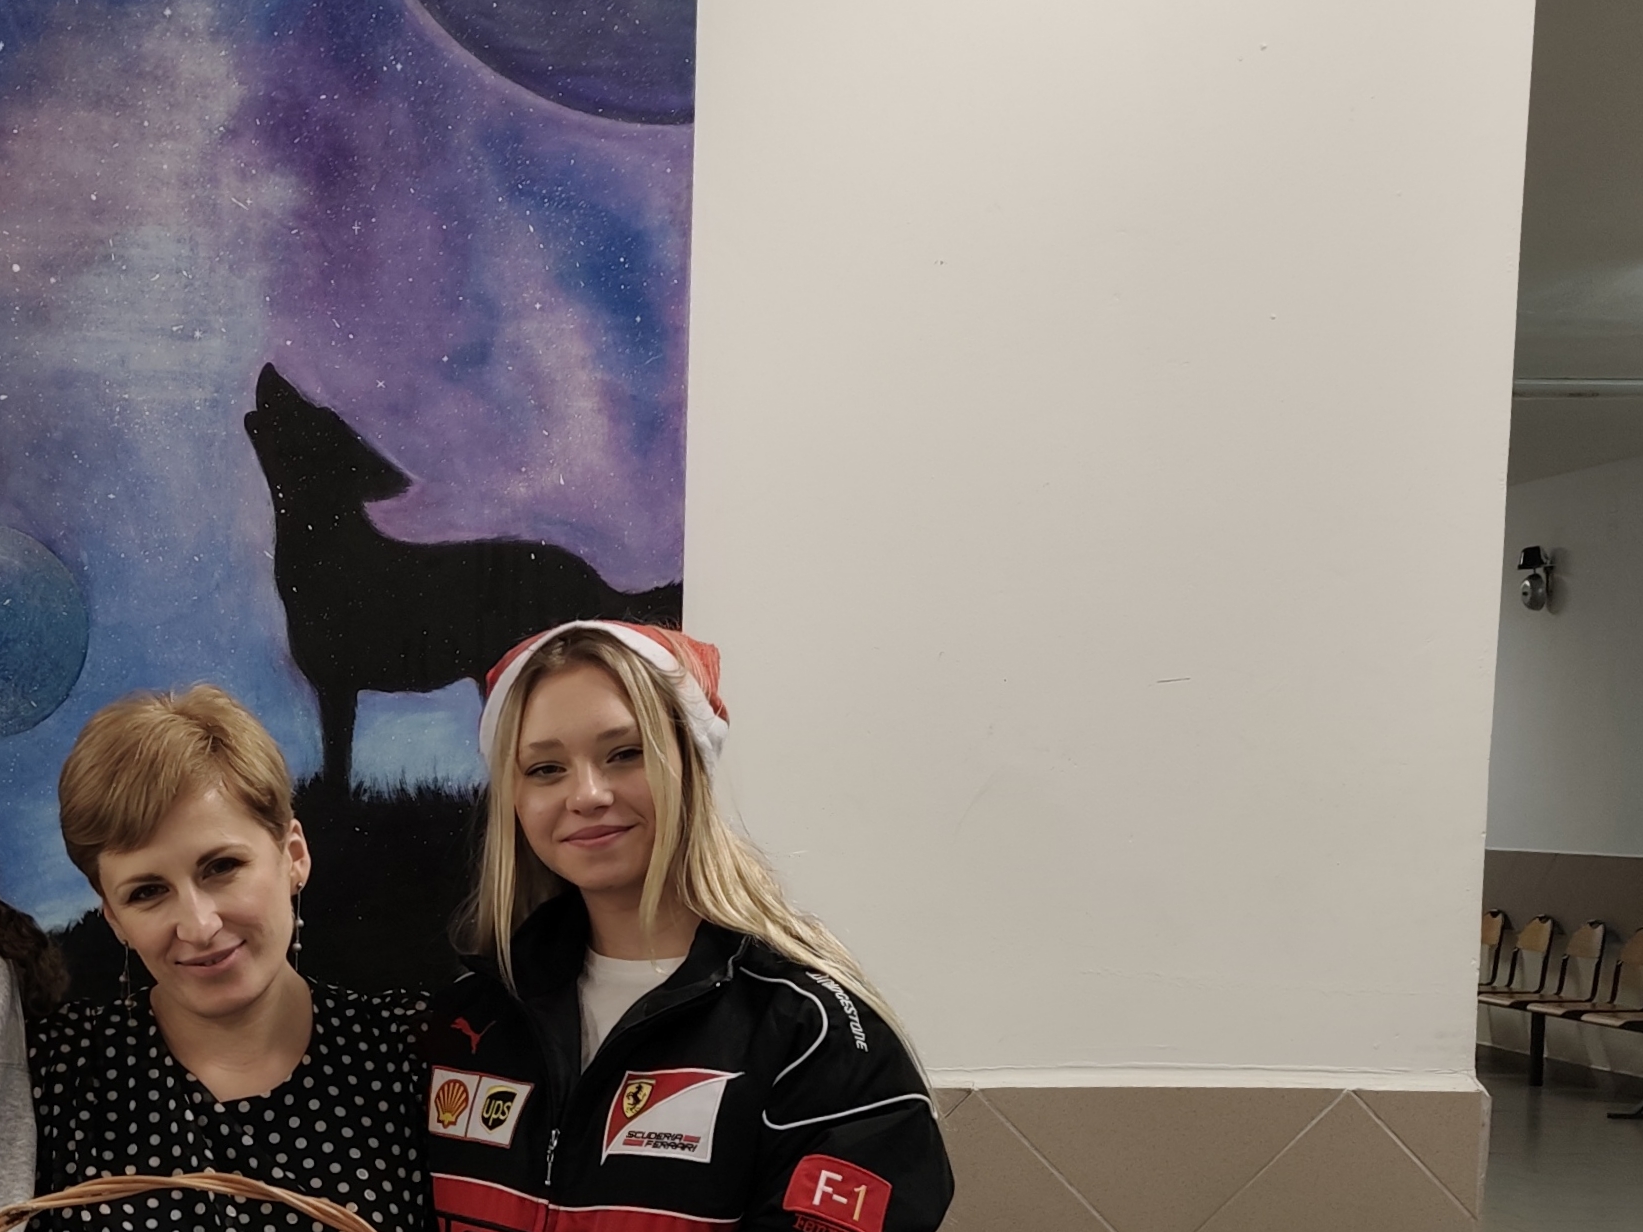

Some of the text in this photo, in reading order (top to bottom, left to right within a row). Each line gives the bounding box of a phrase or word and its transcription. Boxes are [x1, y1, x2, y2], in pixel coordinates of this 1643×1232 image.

[482, 1098, 513, 1127] ups
[625, 1130, 684, 1142] SCUDERIA
[643, 1140, 698, 1153] FERRARI
[812, 1169, 868, 1222] F-1
